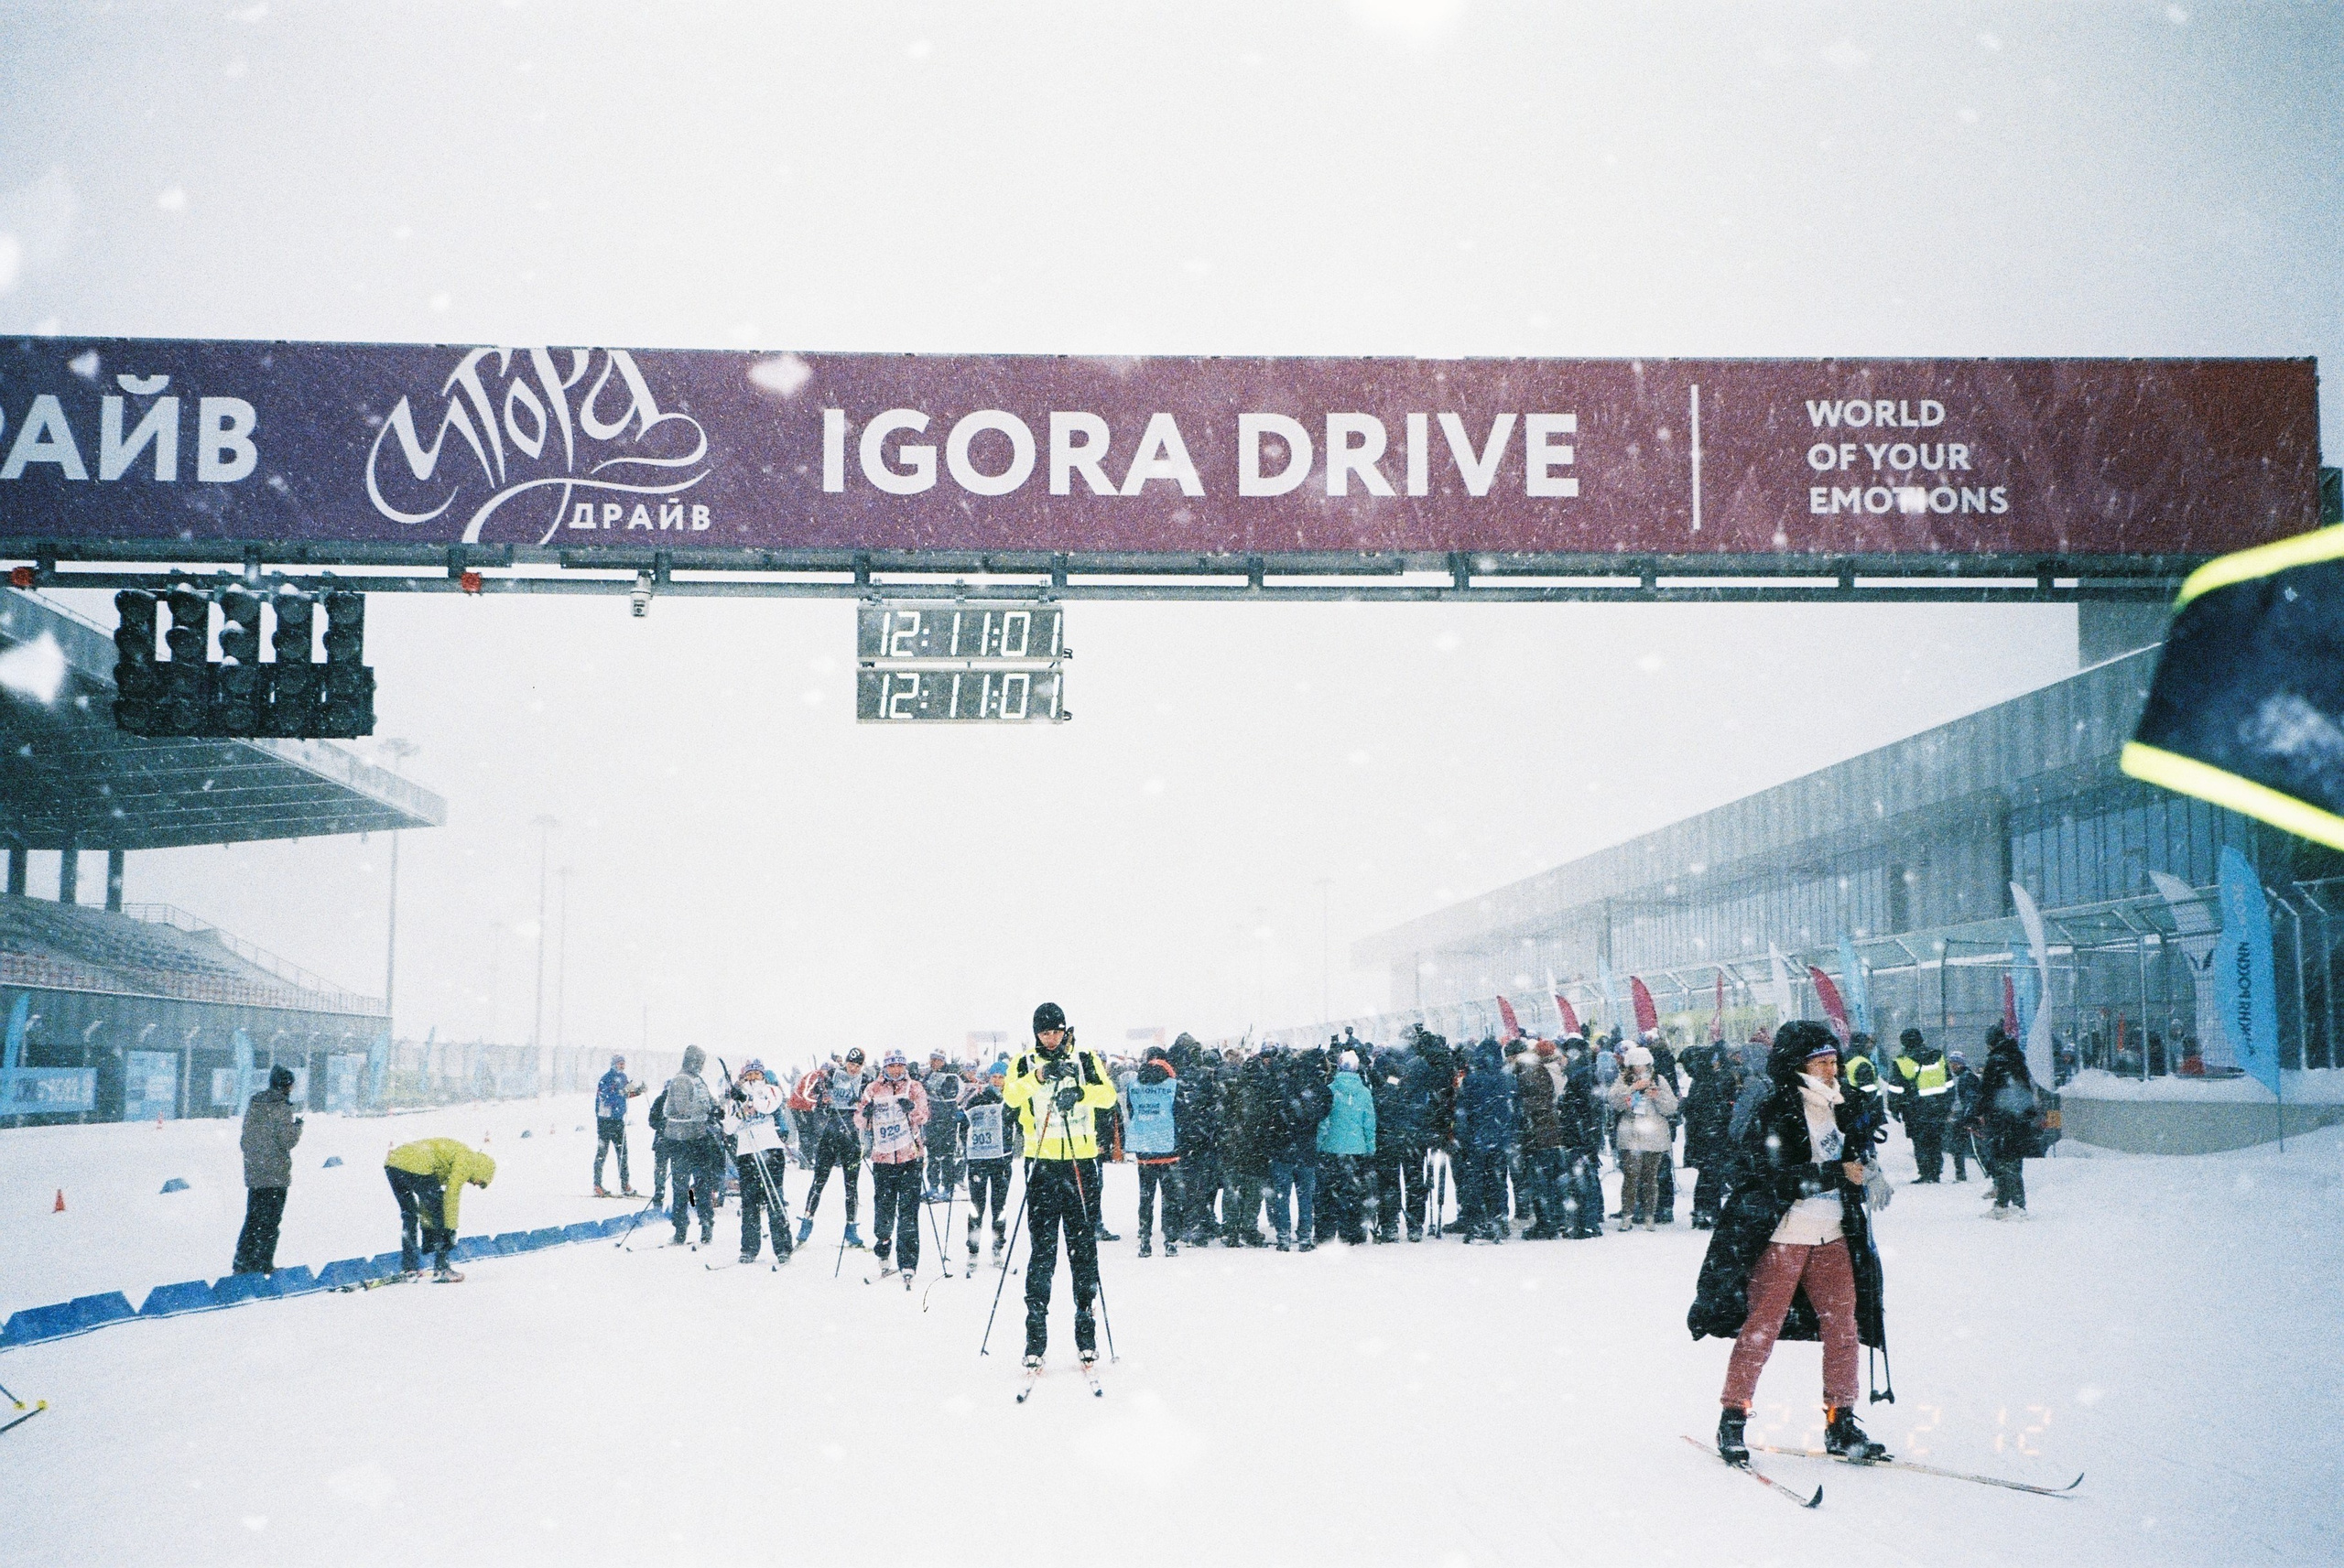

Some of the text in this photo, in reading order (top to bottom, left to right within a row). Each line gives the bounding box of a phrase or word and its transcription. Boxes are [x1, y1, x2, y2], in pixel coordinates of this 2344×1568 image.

[0, 373, 257, 482] АЙВ
[1806, 399, 1946, 427] WORLD
[822, 407, 1580, 499] IGORA DRIVE
[1807, 442, 1971, 471] OF YOUR
[569, 497, 711, 531] ДРАЙВ
[1810, 486, 2009, 514] EMOTIONS
[971, 1132, 993, 1145] 903
